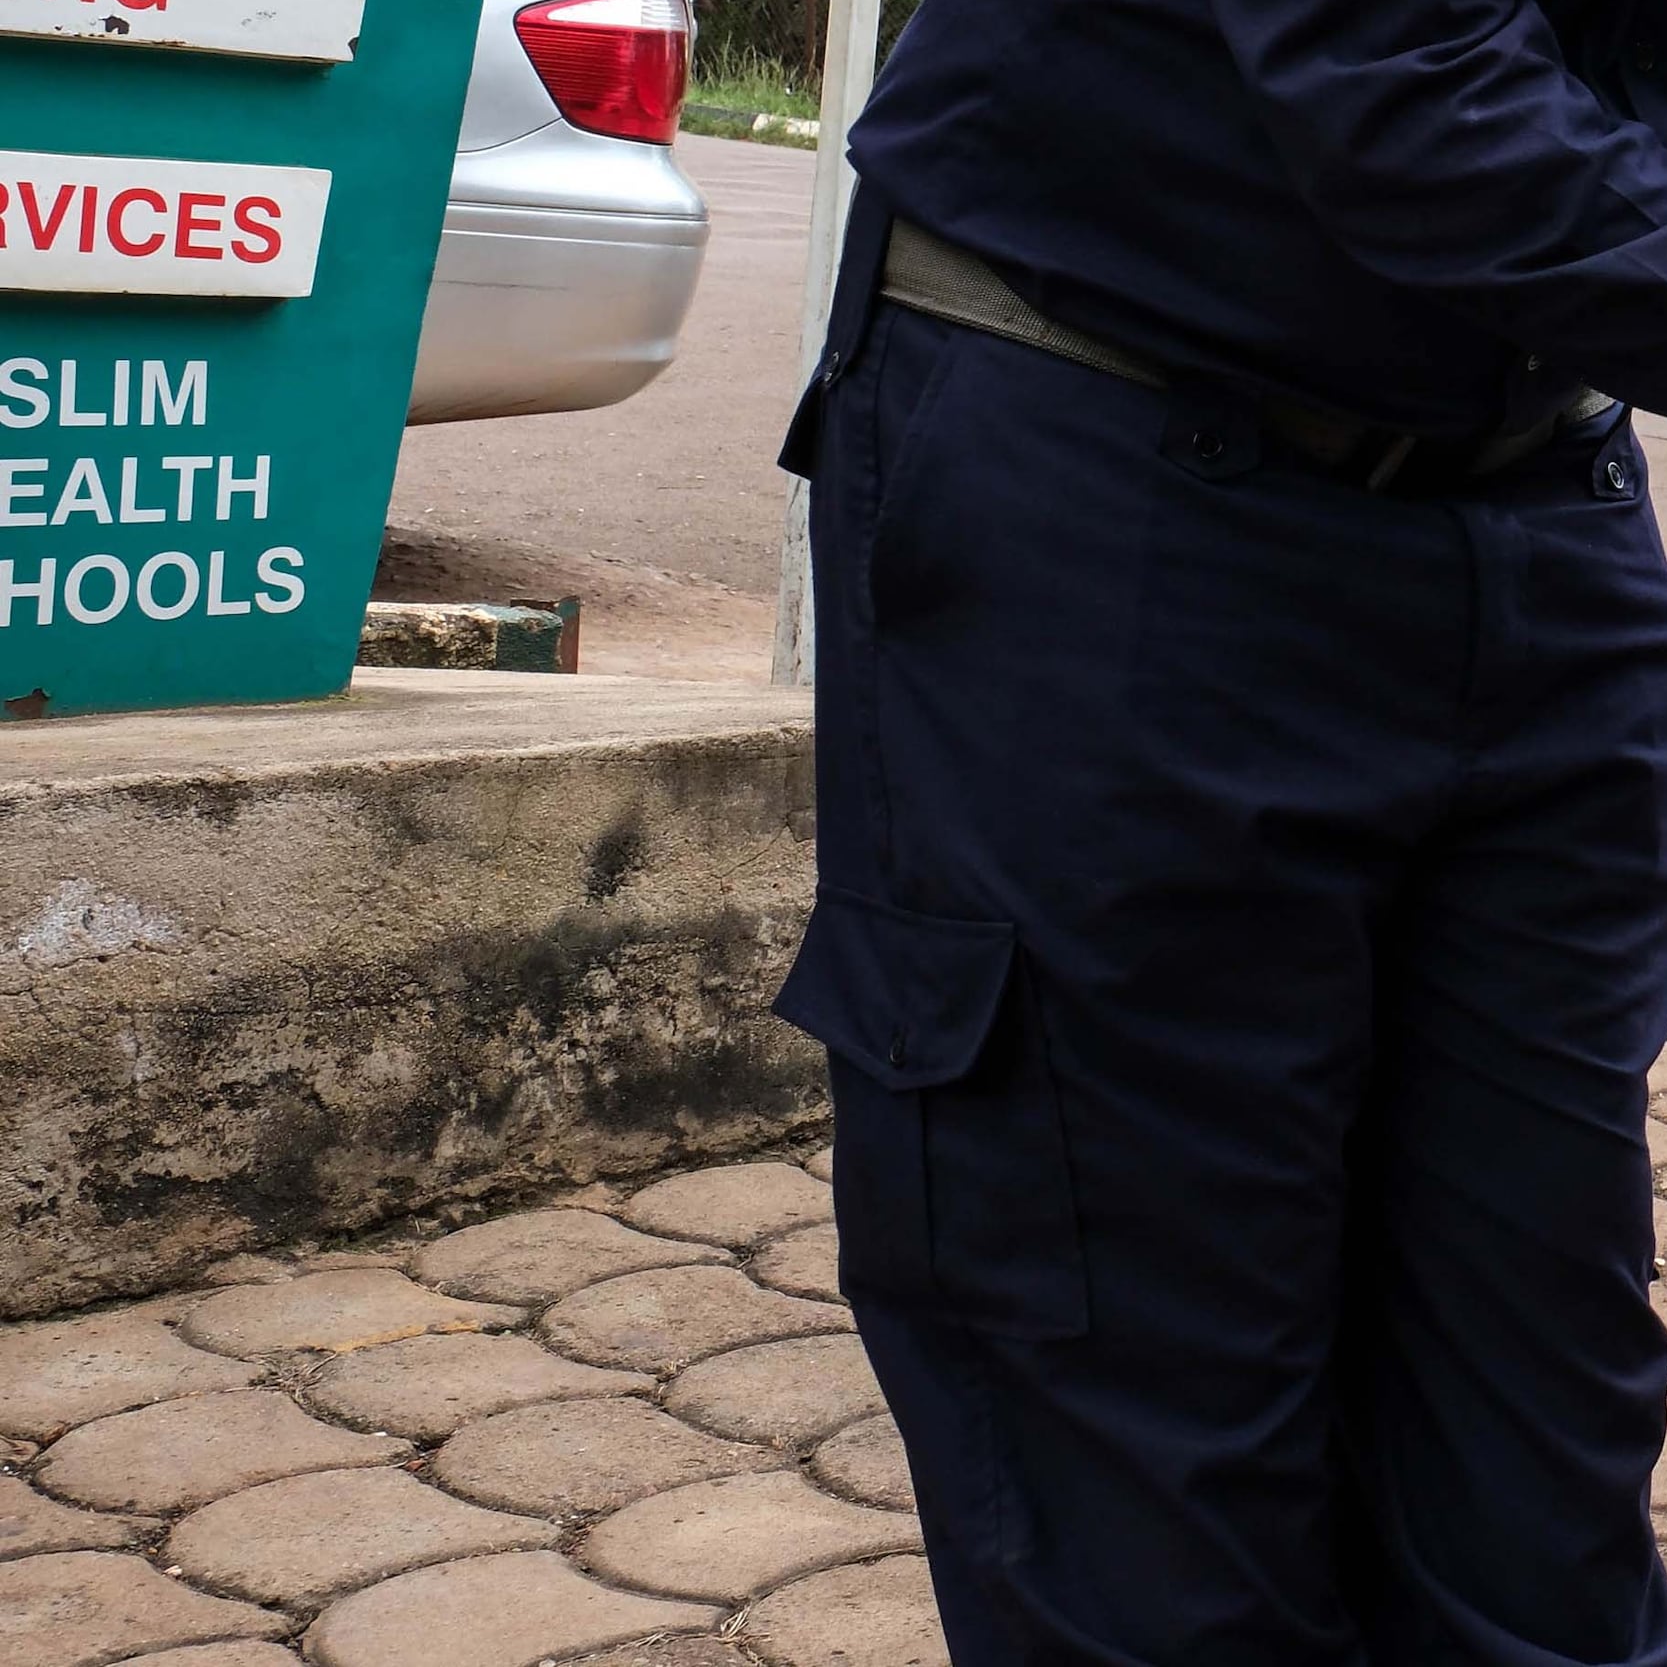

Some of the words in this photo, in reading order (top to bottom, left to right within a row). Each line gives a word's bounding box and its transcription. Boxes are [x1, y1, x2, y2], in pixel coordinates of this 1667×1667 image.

[0, 180, 283, 265] VICES
[0, 357, 208, 427] SLIM
[0, 455, 271, 527] EALTH
[0, 546, 306, 627] HOOLS
